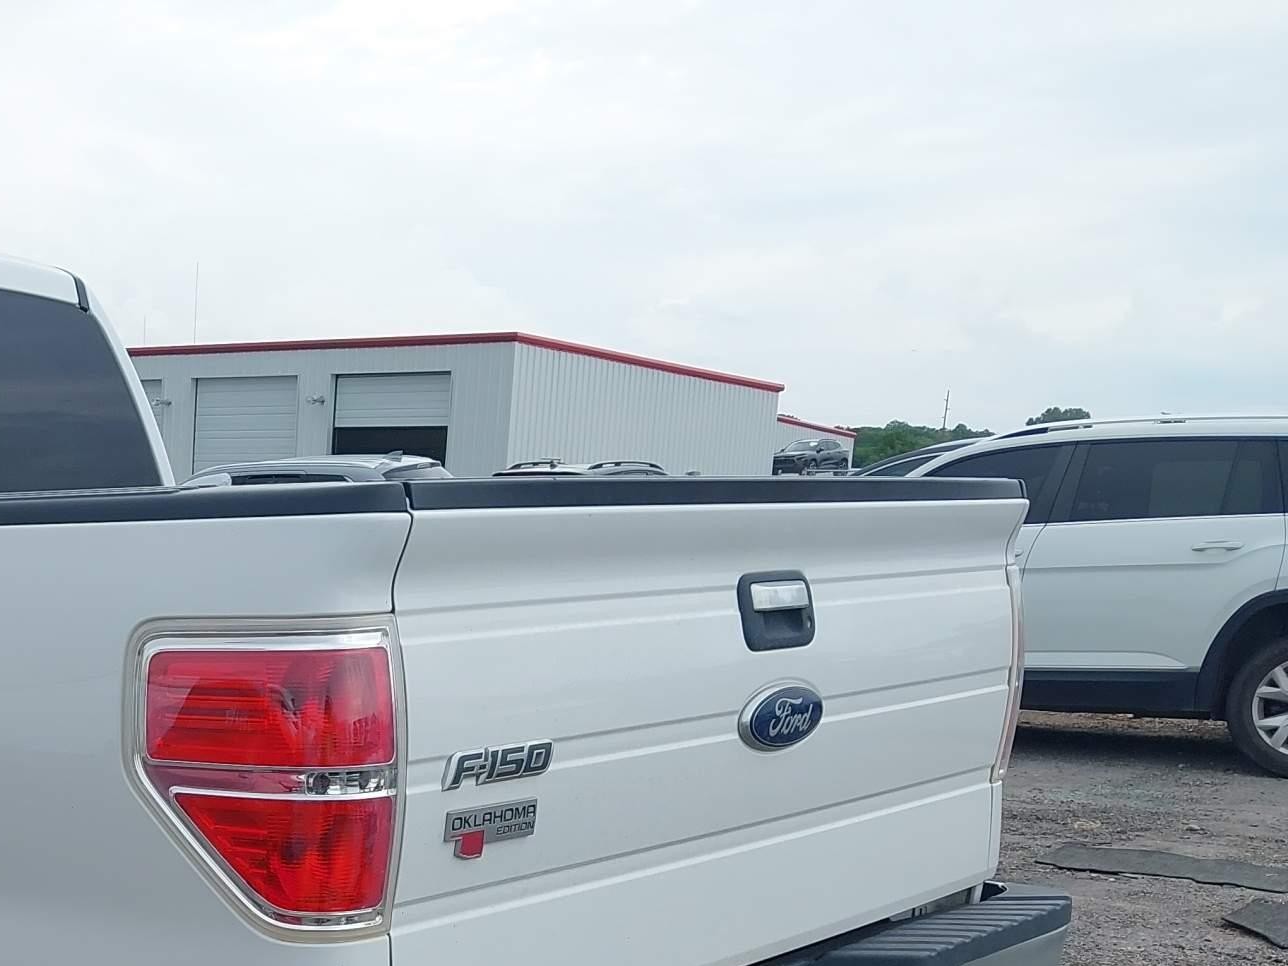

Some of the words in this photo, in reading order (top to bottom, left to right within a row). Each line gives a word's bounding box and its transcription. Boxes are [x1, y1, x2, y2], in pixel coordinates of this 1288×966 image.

[768, 696, 814, 738] Ford
[443, 740, 554, 791] F-150
[451, 803, 537, 832] OKLAHOMA
[495, 820, 535, 836] EDITION
